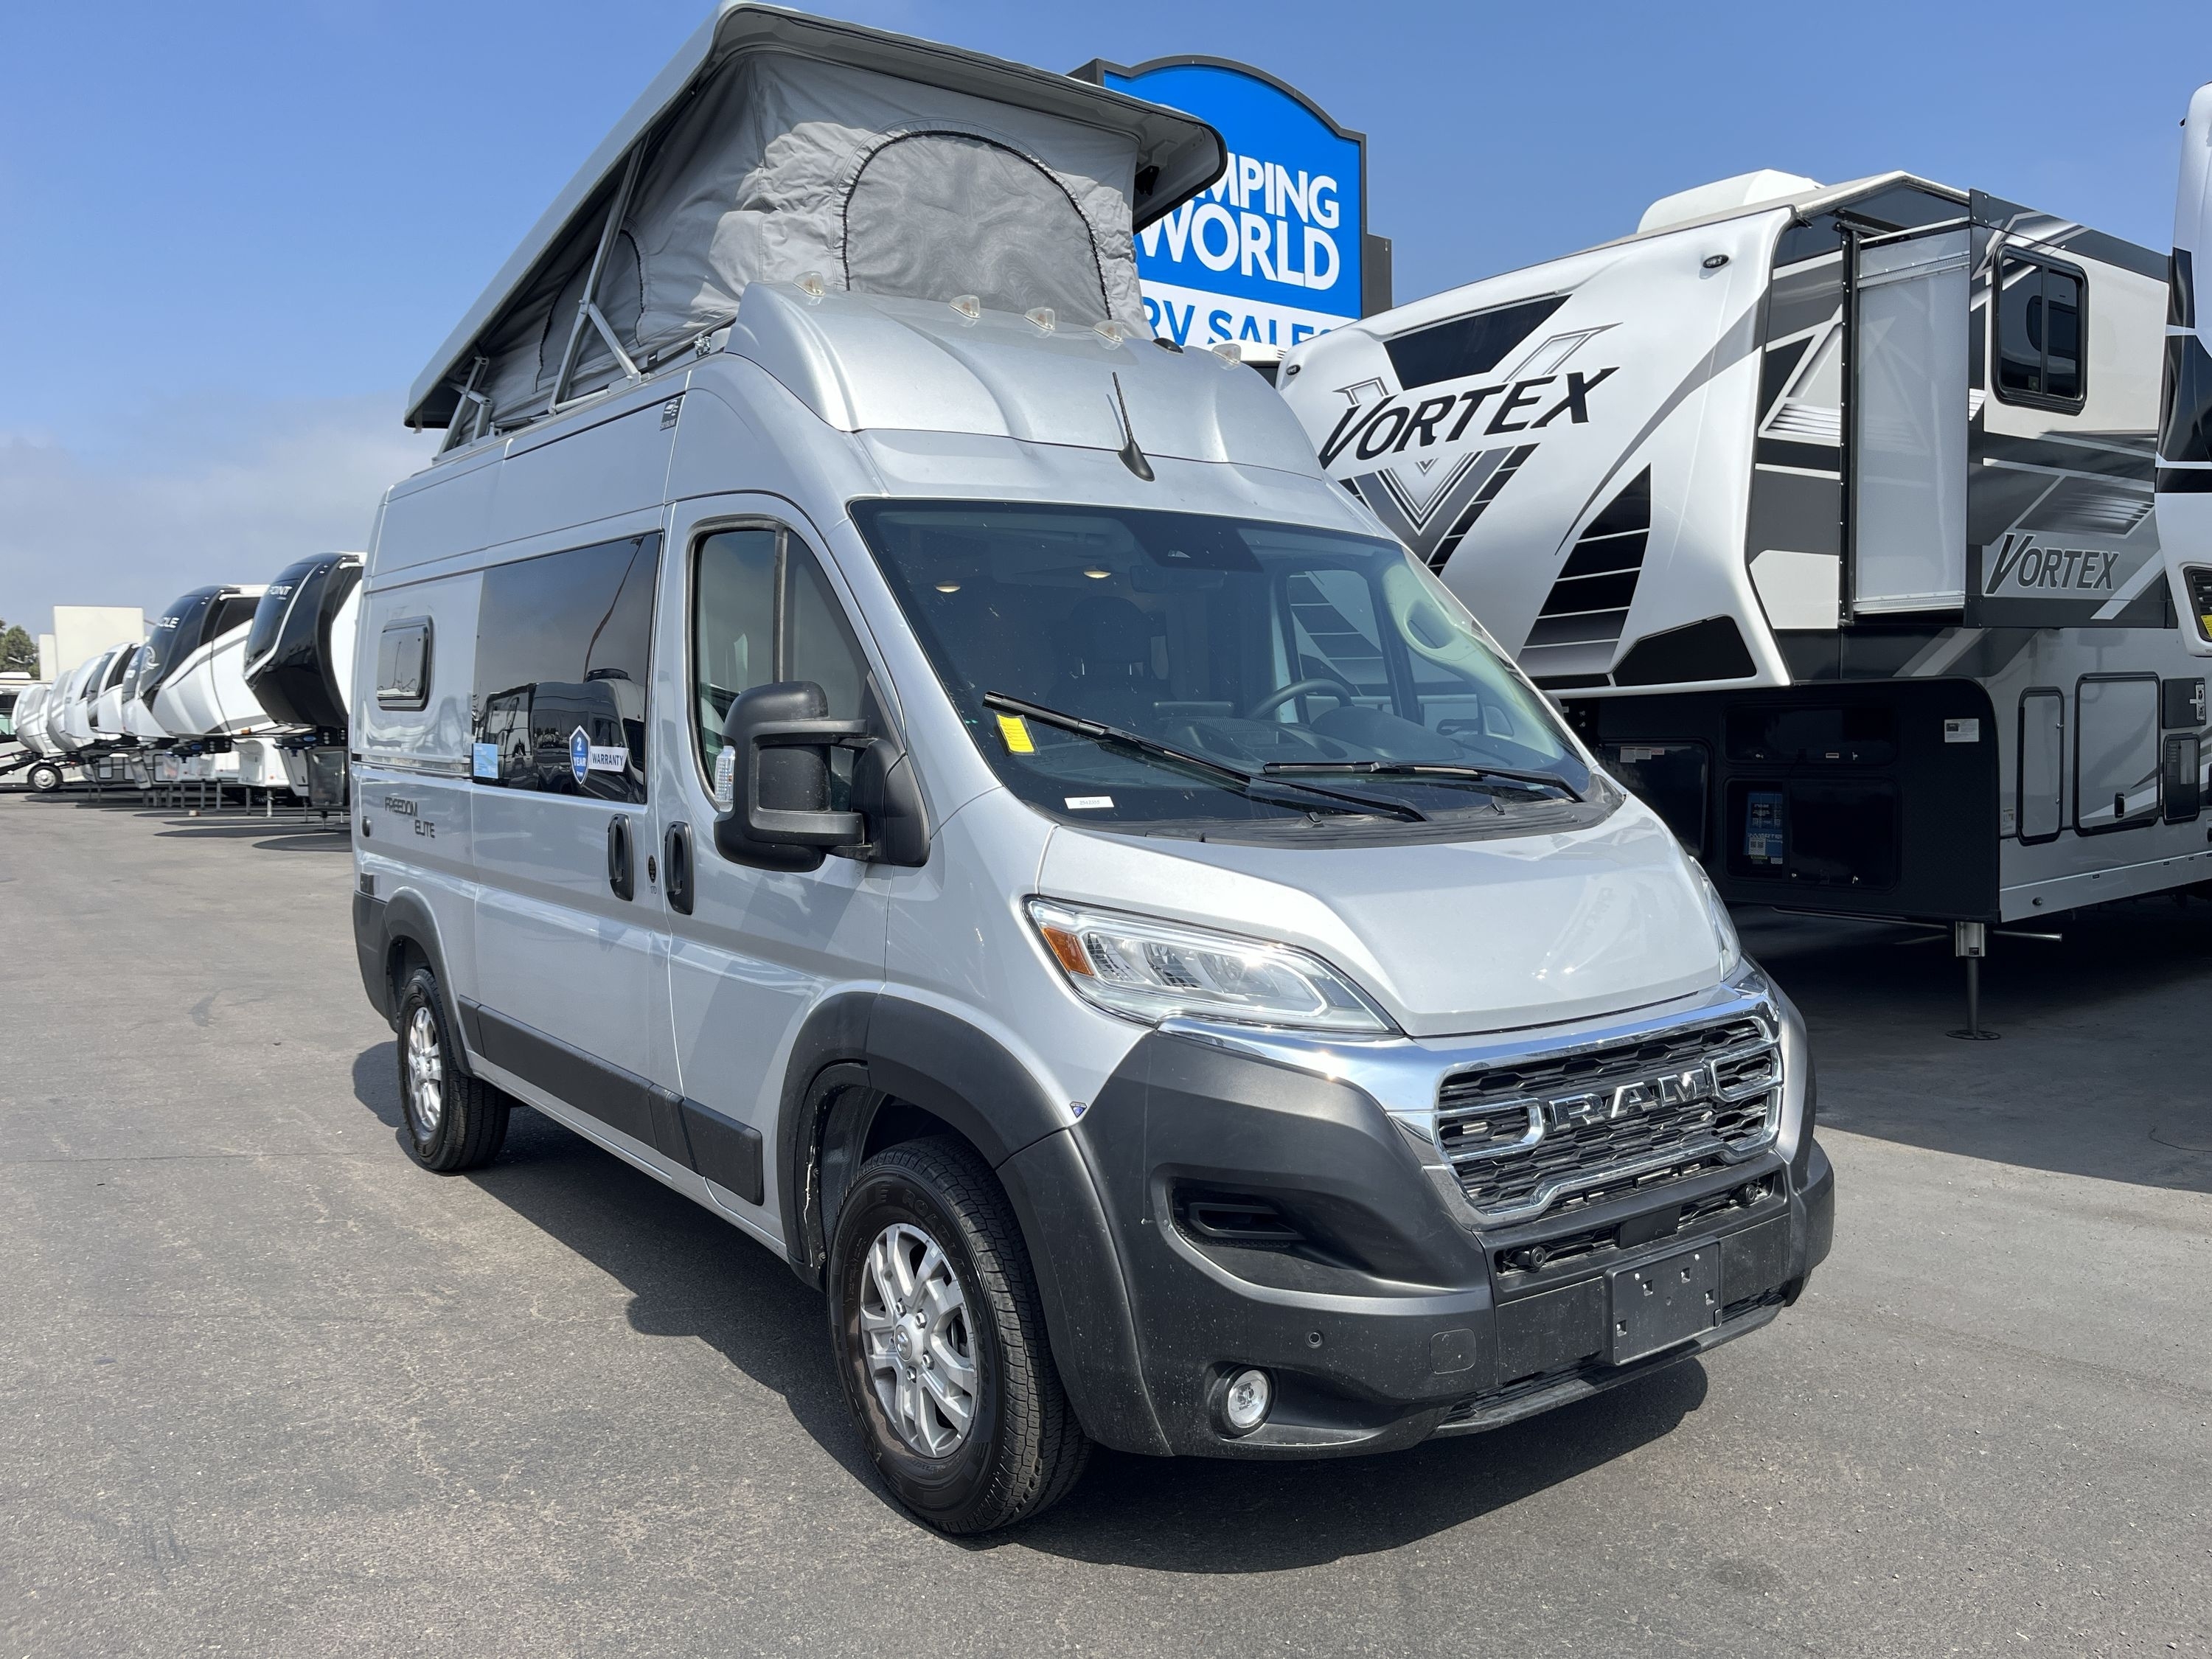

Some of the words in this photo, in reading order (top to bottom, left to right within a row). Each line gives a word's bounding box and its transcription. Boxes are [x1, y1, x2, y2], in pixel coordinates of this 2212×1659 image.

[1194, 152, 1338, 229] MPING
[1140, 200, 1340, 291] WORLD
[1142, 296, 1195, 346] RV
[1207, 310, 1332, 347] SALE
[1318, 366, 1621, 470] VORTEX
[1984, 532, 2120, 596] VORTEX
[573, 757, 586, 767] YEAR
[577, 737, 582, 751] 2
[592, 754, 623, 767] WARRANTY
[385, 796, 418, 817] FREEDOM
[414, 819, 435, 838] ELITE
[1549, 1068, 1710, 1132] RAM
